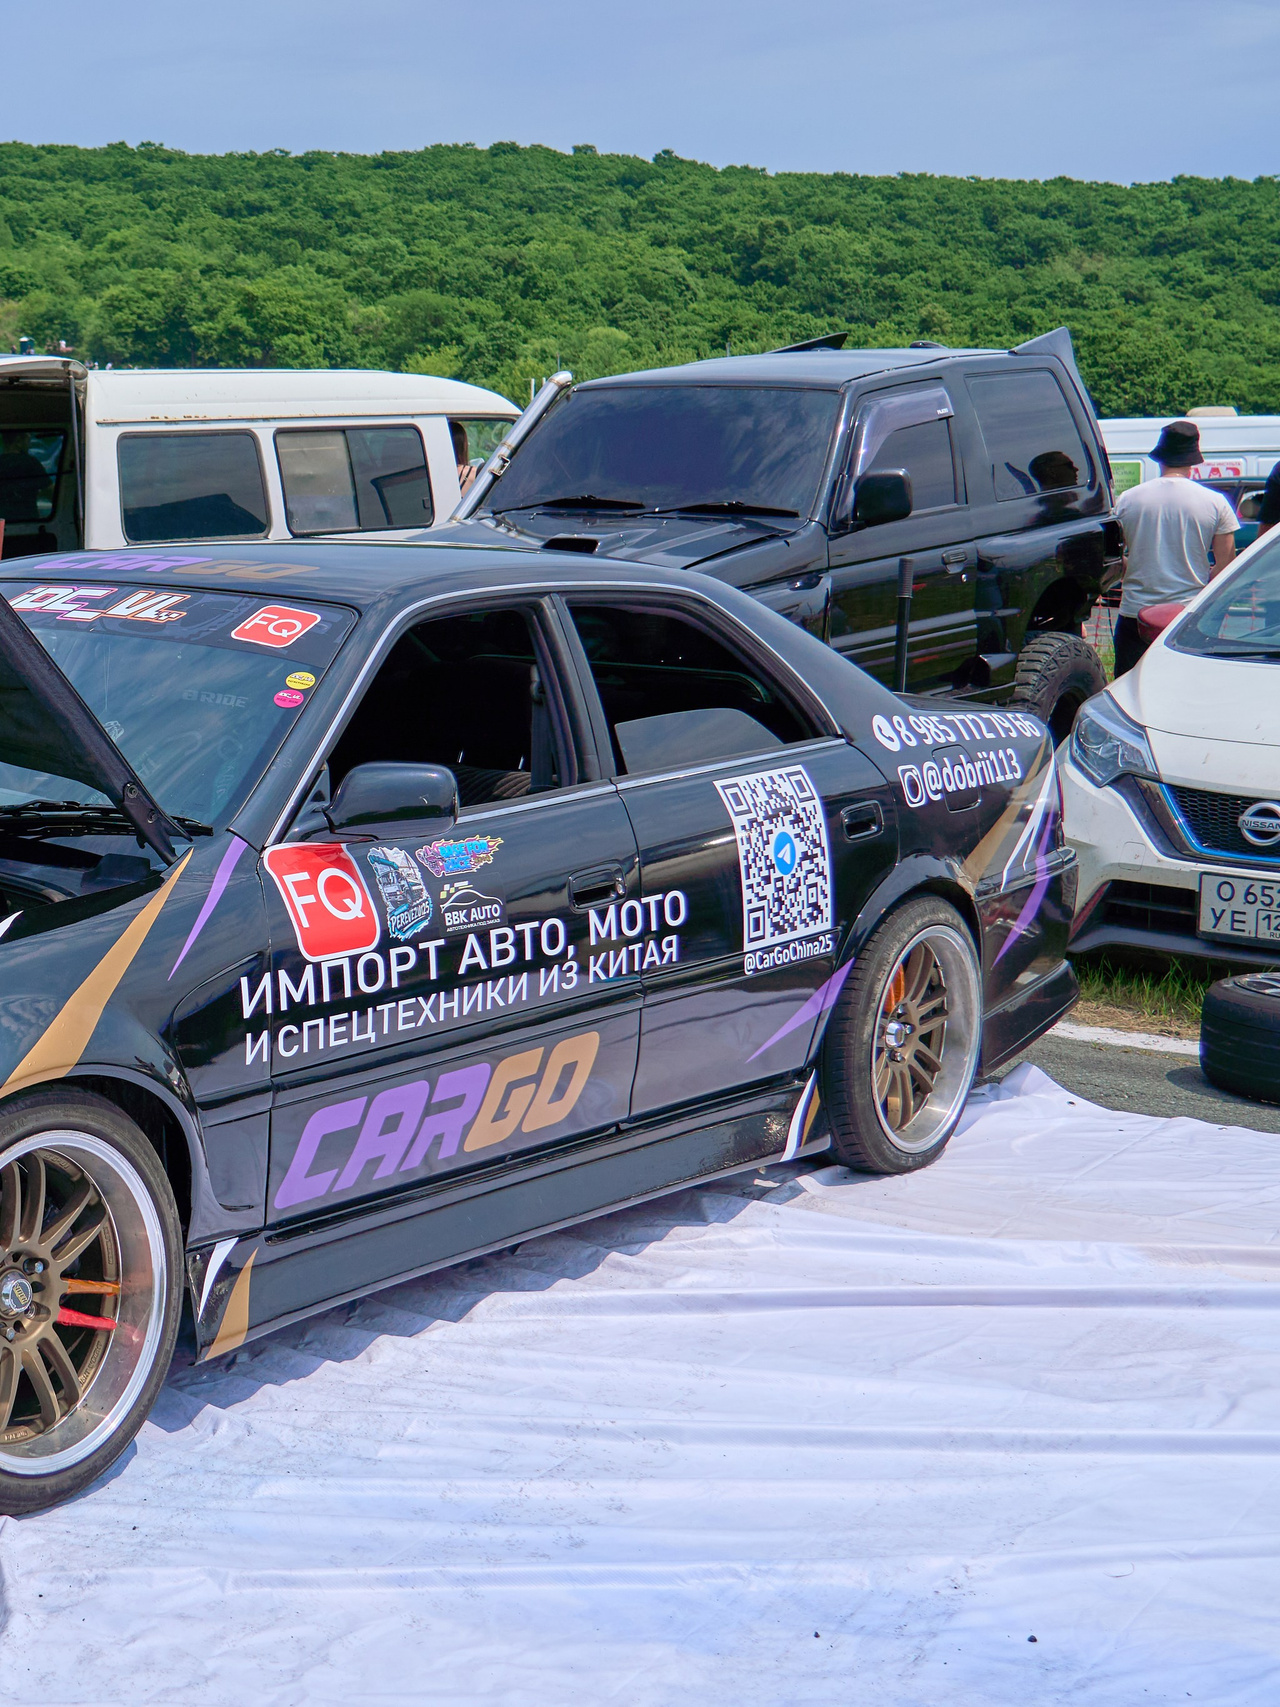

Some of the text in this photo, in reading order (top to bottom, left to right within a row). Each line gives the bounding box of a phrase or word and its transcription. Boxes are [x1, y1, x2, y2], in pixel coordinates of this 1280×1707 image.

[34, 554, 320, 580] CARGO
[245, 613, 303, 638] FQ
[893, 713, 1041, 747] 8 985 772 79 66
[922, 747, 1021, 801] @dobrii113
[282, 867, 365, 928] FQ
[444, 904, 500, 926] BBK AUTO
[1243, 884, 1280, 908] 65
[241, 890, 687, 1019] ИМПОРТ АВТО, МОТО
[743, 935, 833, 976] @CarGoChina25
[245, 934, 679, 1065] И СПЕЦТЕХНИКИ ИЗ КИТАЯ
[274, 1031, 600, 1210] CARGO
